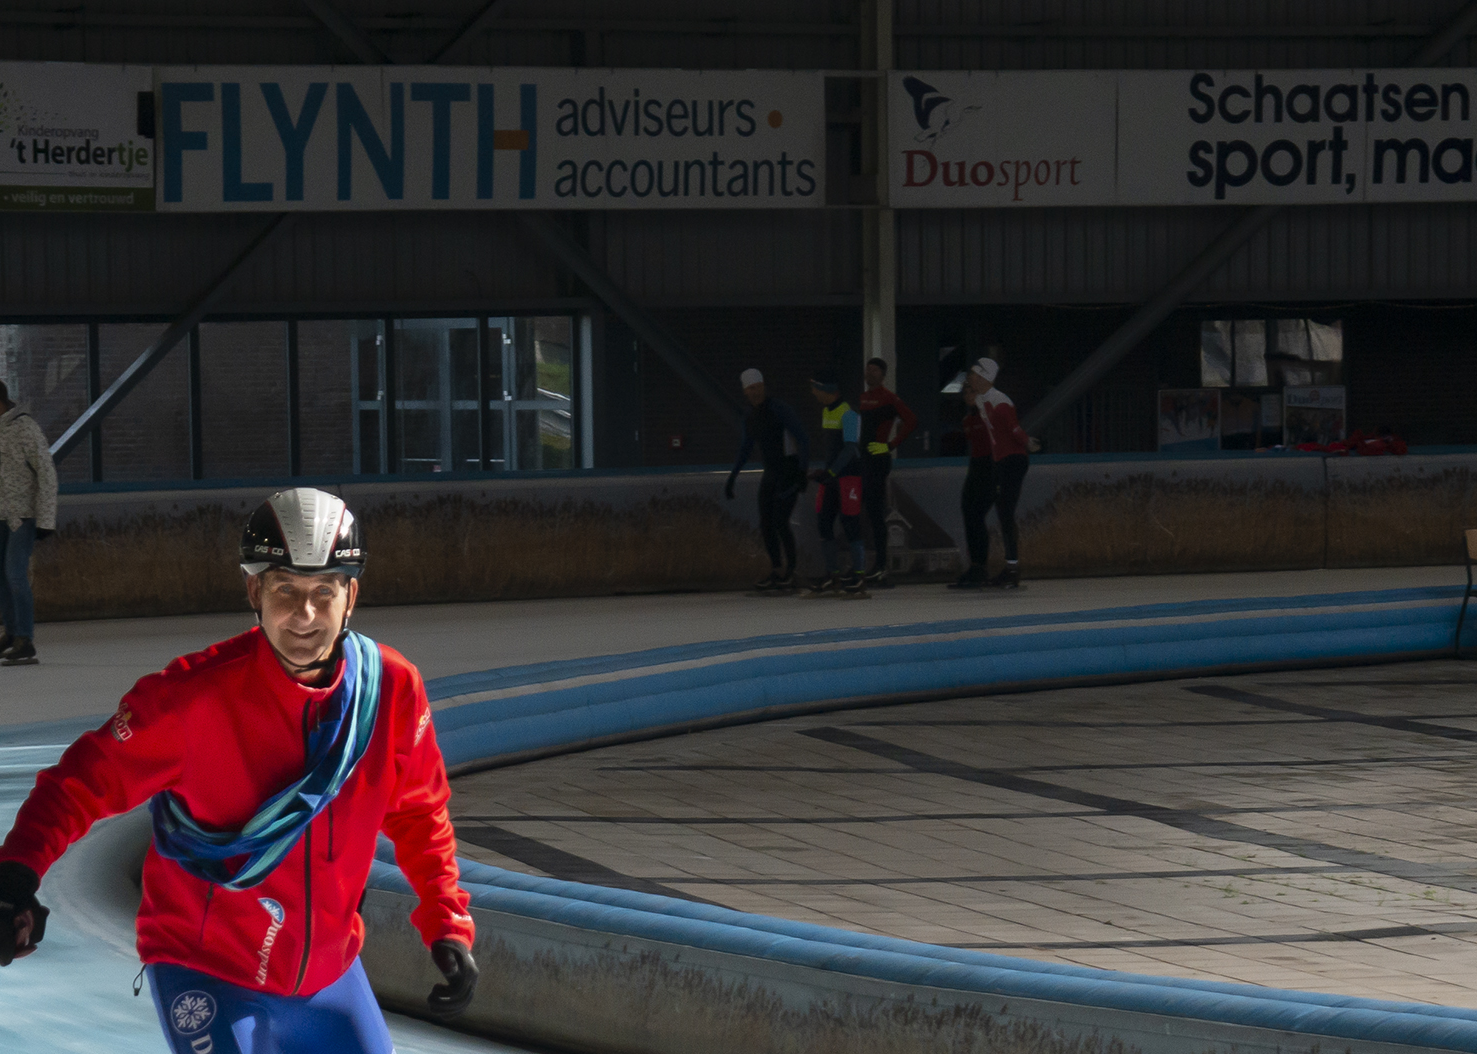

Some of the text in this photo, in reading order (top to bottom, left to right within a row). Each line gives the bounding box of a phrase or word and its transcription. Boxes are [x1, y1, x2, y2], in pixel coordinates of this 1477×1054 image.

[555, 86, 756, 137] adviseurs
[1188, 73, 1470, 124] Schaatsen
[17, 125, 100, 141] Kinderopvang
[32, 137, 149, 172] Herdertje
[161, 82, 537, 202] FLYNTH
[554, 151, 816, 198] accountants
[902, 149, 1082, 202] Duosport
[1187, 126, 1477, 200] sport, ma
[11, 192, 135, 207] veilig en vertrouwd
